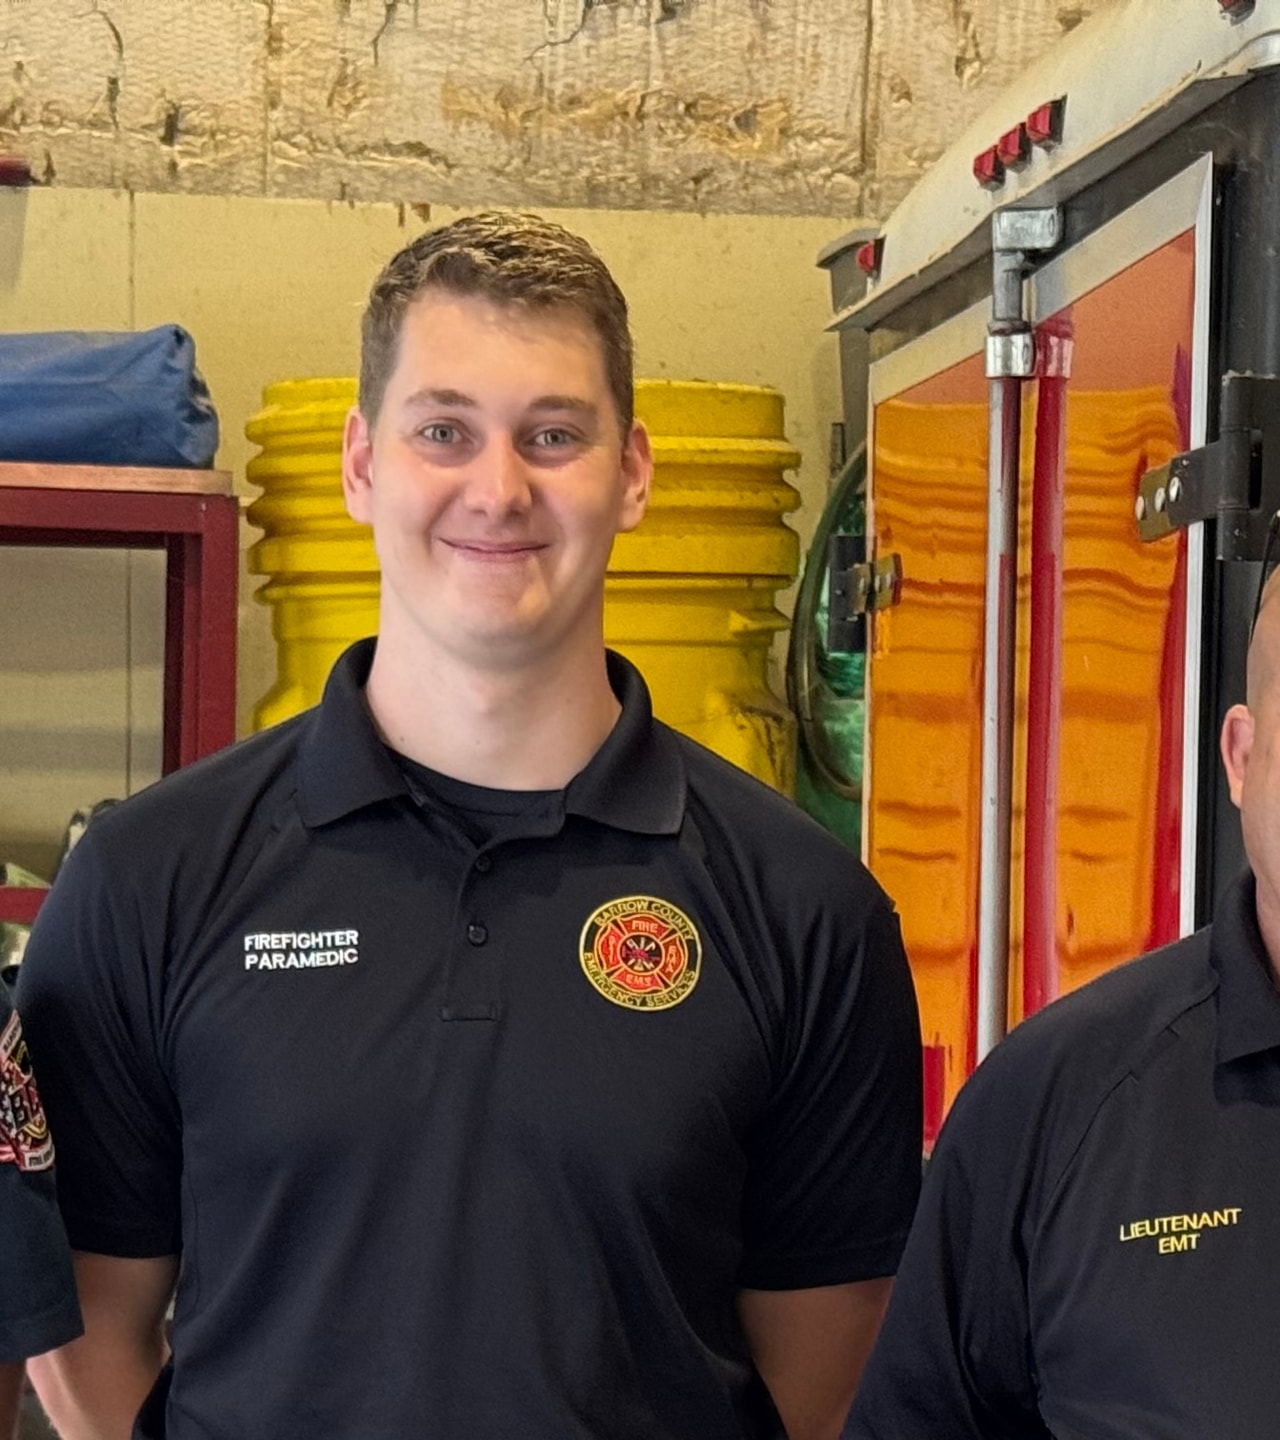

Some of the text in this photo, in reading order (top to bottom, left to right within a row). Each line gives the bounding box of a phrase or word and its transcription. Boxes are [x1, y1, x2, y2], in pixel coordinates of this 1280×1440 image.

[593, 900, 695, 940] BARROW COUNTY
[244, 930, 360, 952] FIREFIGHTER
[245, 948, 360, 970] PARAMEDIC
[583, 951, 697, 1007] EMERGENCY SERVICES
[1120, 1207, 1243, 1242] LIEUTENANT
[1159, 1233, 1201, 1254] EMT
